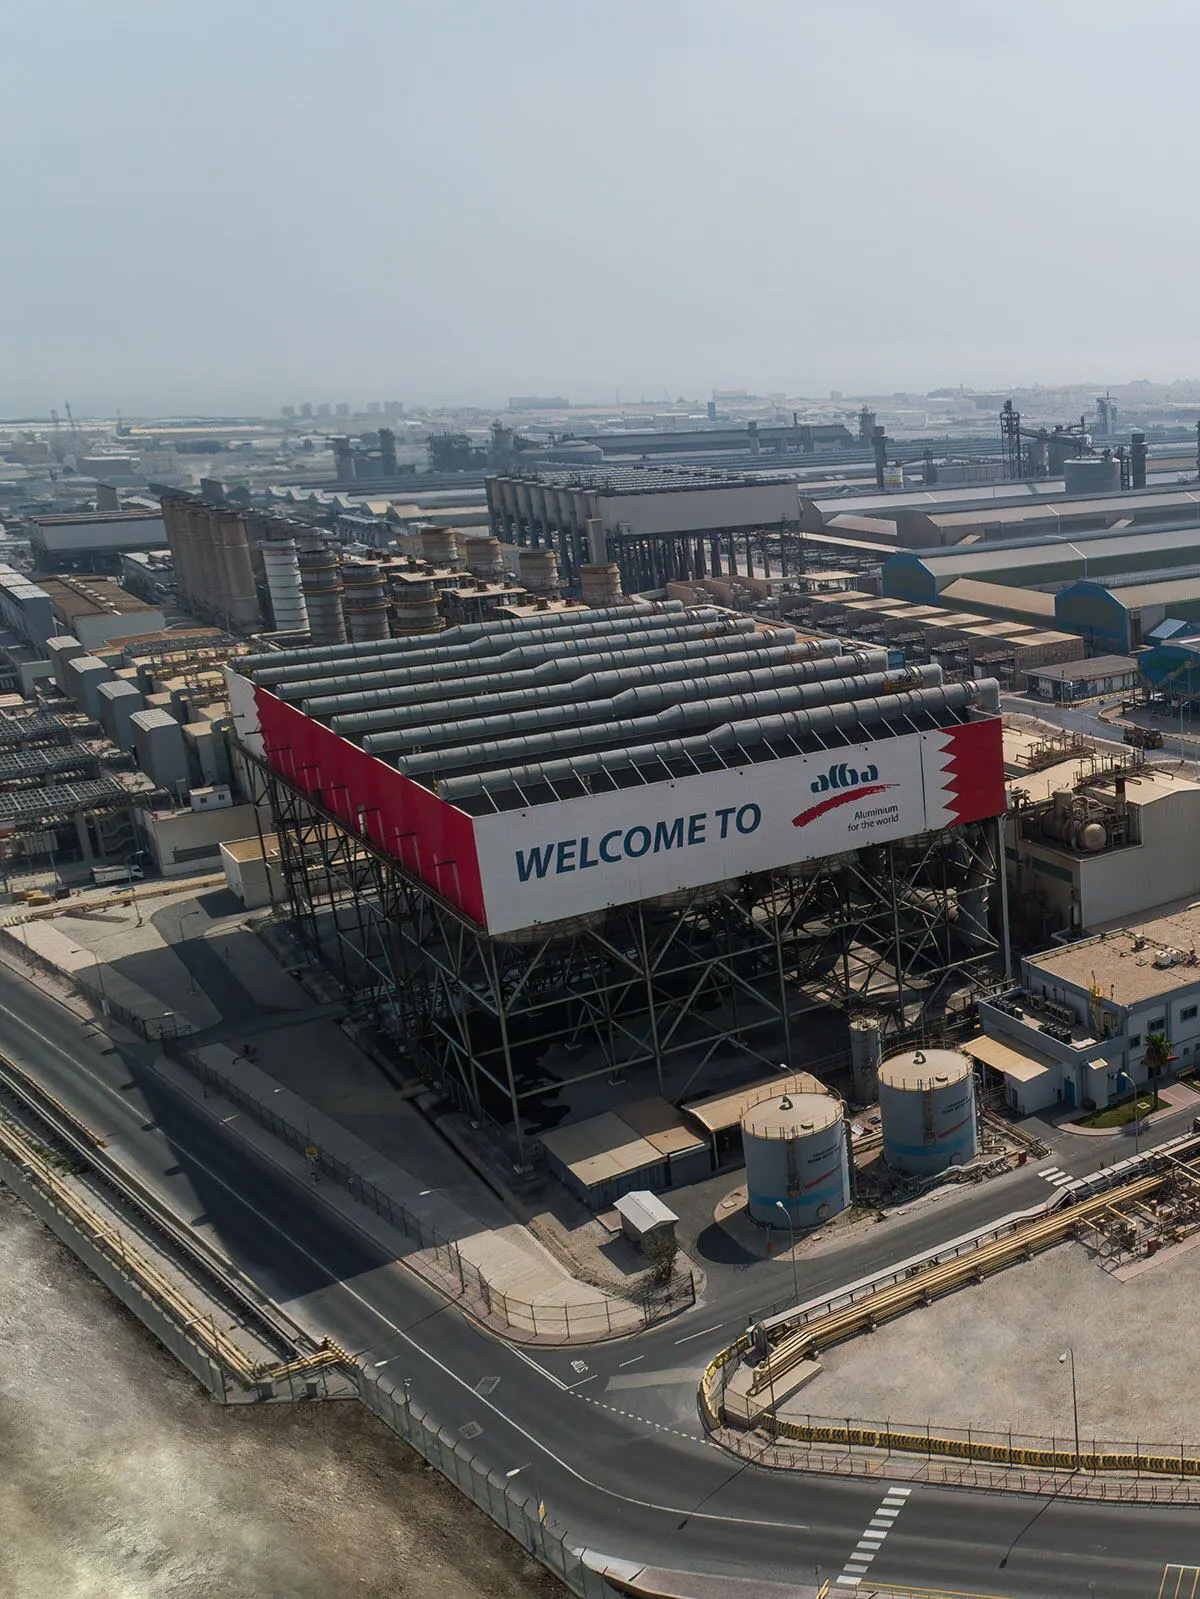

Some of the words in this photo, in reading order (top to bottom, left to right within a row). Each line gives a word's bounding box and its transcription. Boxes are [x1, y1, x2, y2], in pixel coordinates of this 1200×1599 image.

[810, 763, 878, 793] alba
[848, 823, 859, 832] for
[861, 820, 875, 830] the
[876, 814, 899, 827] world
[854, 805, 898, 820] Aluminium
[515, 813, 707, 882] WELCOME
[715, 803, 762, 838] TO
